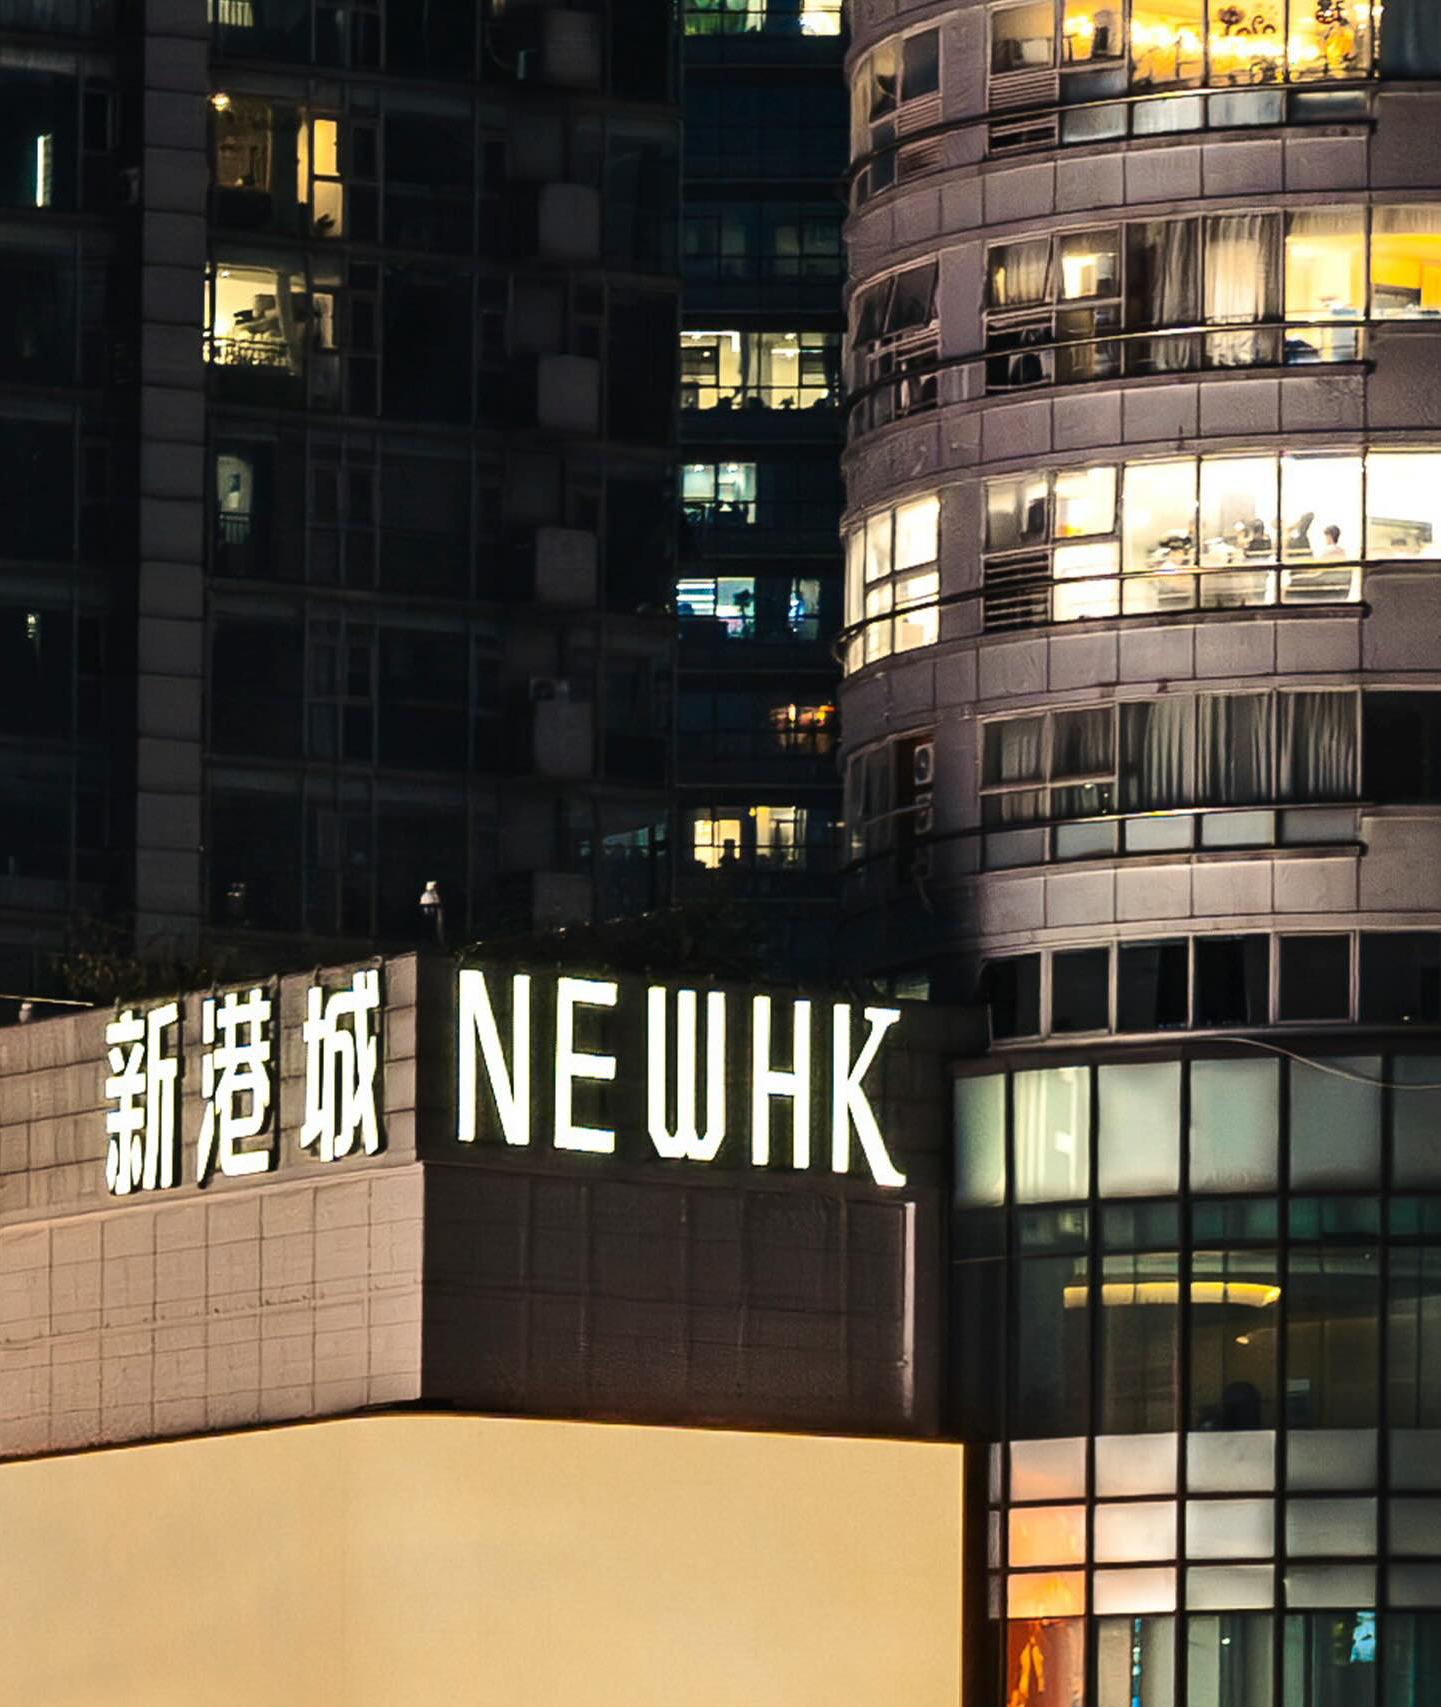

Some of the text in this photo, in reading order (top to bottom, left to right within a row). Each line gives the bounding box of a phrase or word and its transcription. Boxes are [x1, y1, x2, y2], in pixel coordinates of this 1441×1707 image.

[105, 969, 381, 1195] 新港城
[457, 969, 907, 1187] NEWHK
